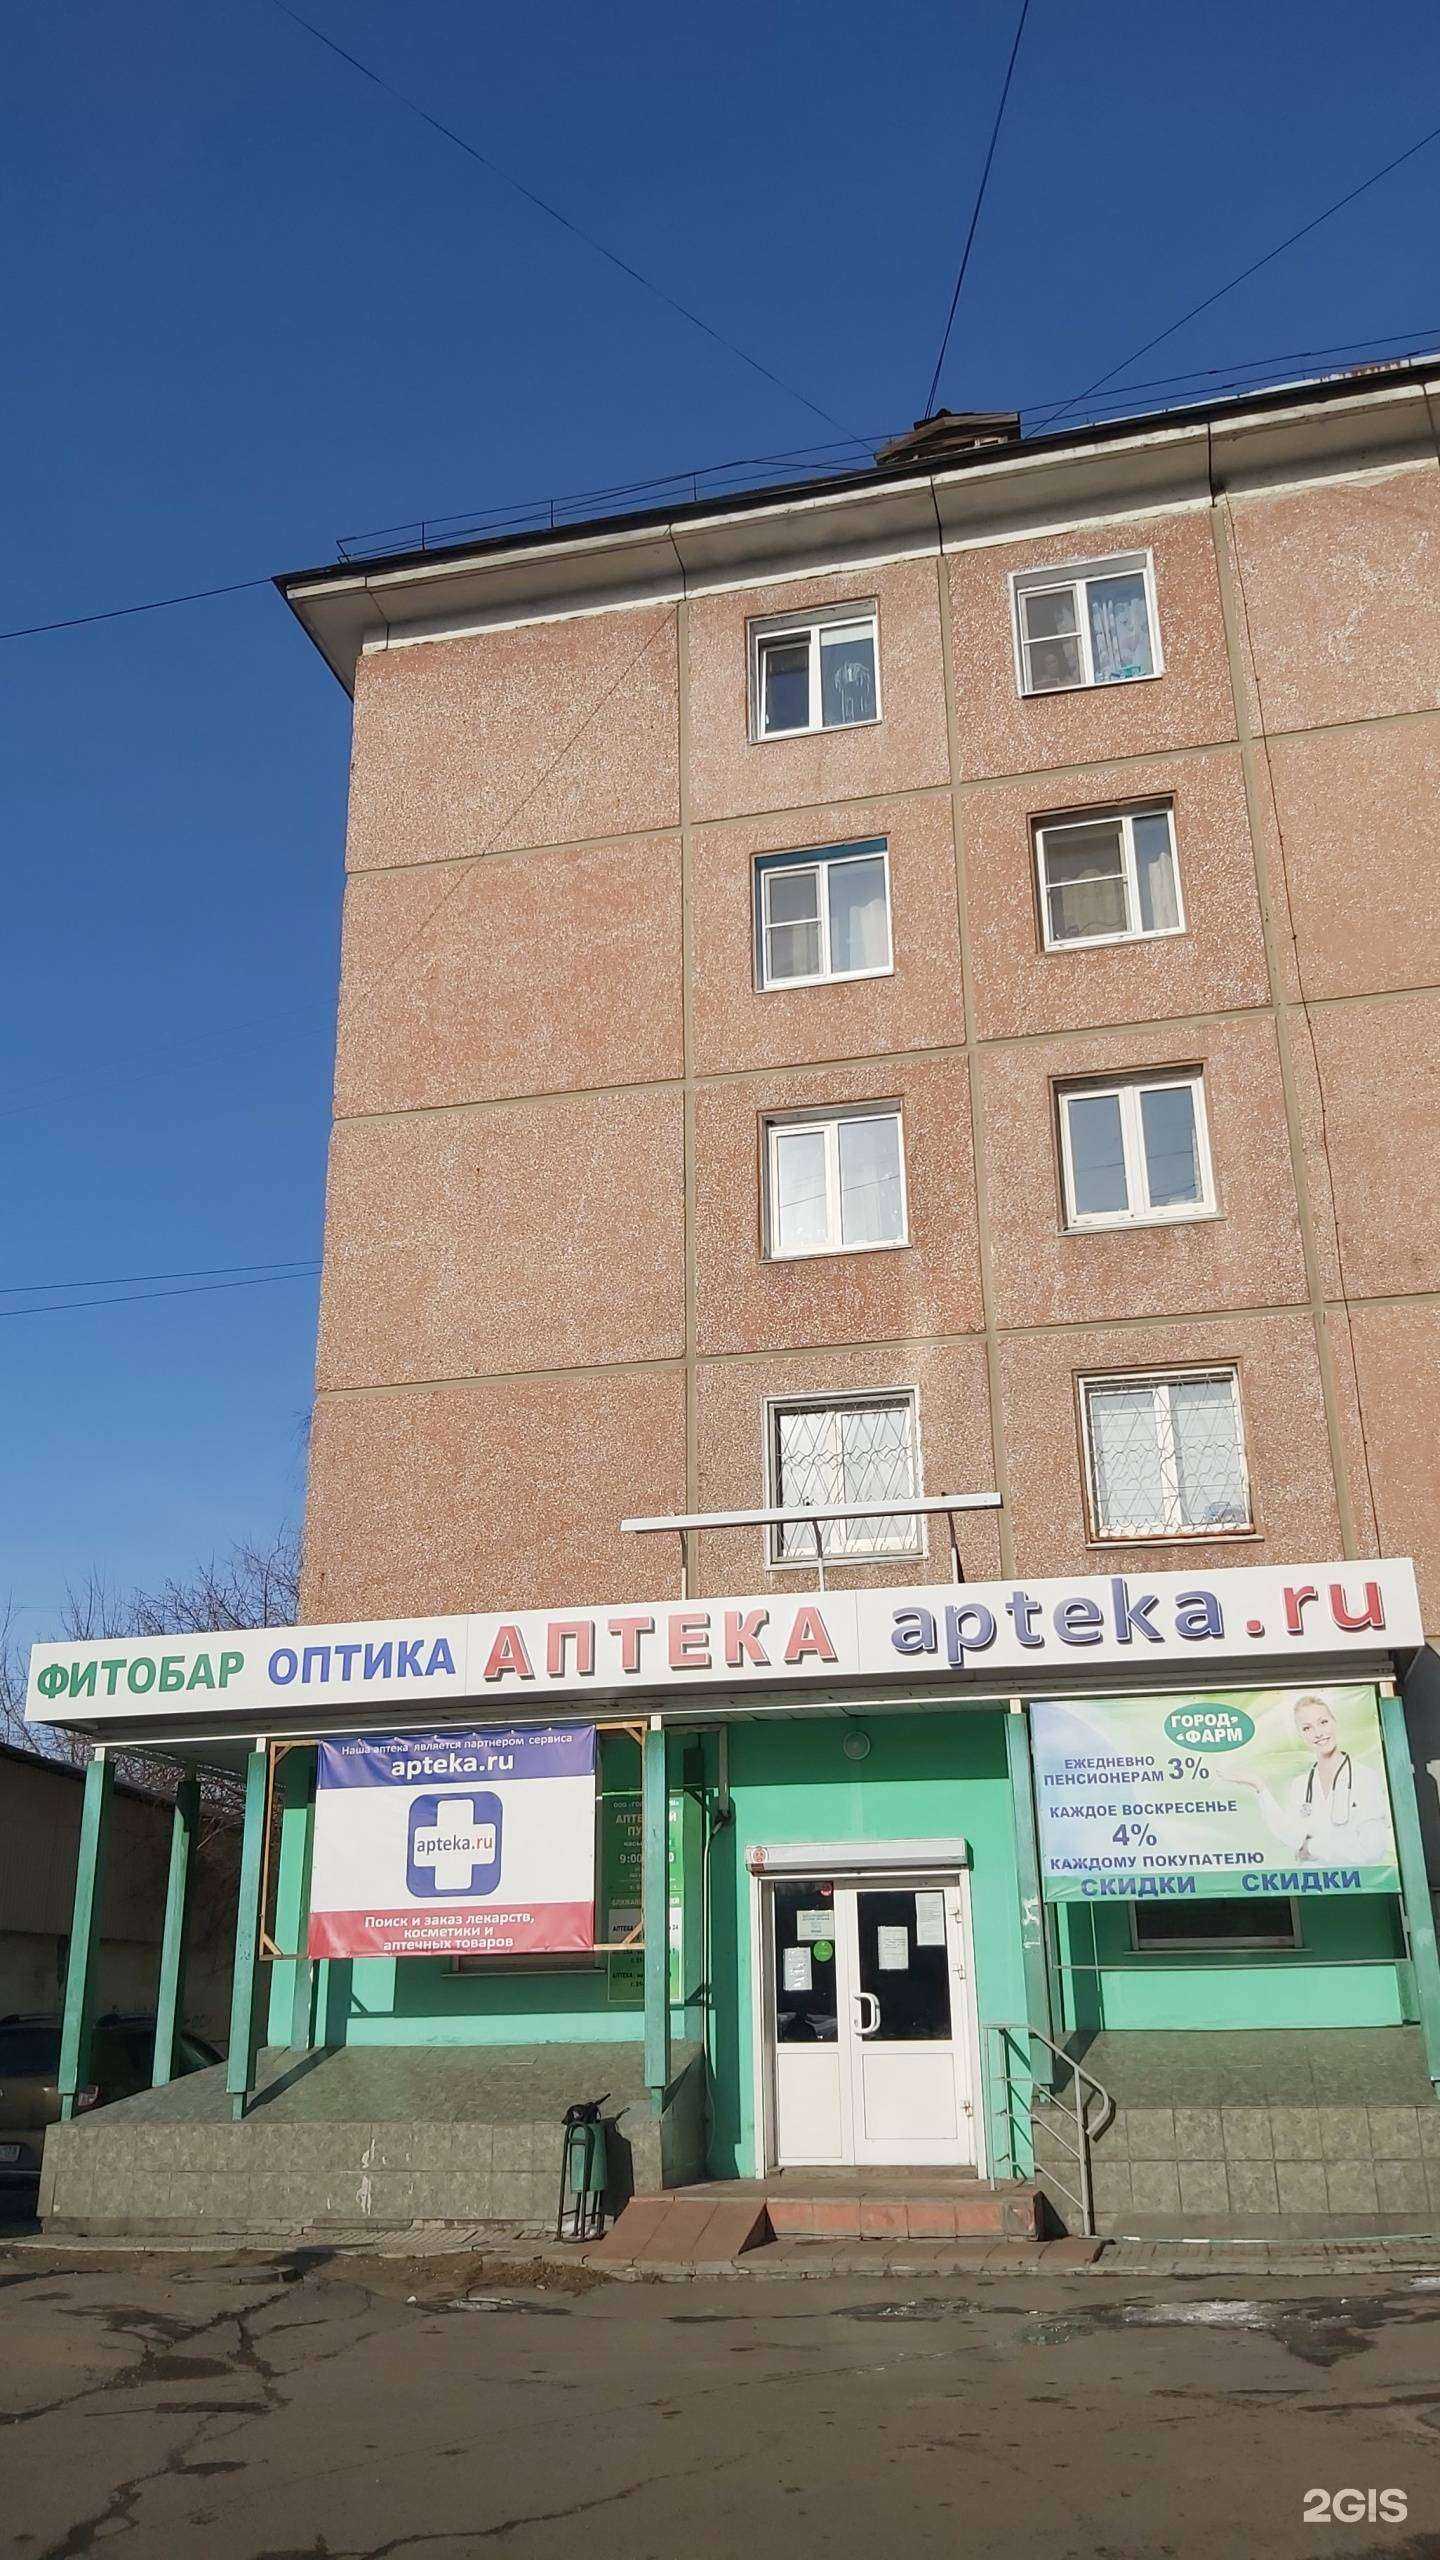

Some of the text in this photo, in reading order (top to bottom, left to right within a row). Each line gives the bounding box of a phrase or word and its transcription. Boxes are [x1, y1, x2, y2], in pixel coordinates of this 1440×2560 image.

[37, 1577, 1386, 1698] ФИТОБАР ОПТИКА АПТЕКА apteka.ru
[342, 1734, 573, 1755] Наша аптека является партнером сервиса
[391, 1753, 514, 1780] apteka.ru
[1065, 1756, 1209, 1780] ЕЖЕДНЕВНО 3%
[1044, 1771, 1164, 1786] ПЕНСИОНЕРАМ
[1050, 1800, 1238, 1819] КАЖДОЕ ВОСКРЕСЕНЬЕ
[417, 1834, 493, 1855] apteka.ru
[1112, 1823, 1157, 1846] 4%
[1051, 1852, 1264, 1871] КАЖДОМУ ПОКУПАТЕЛЮ
[1081, 1870, 1361, 1897] СКИДКИ СКИДКИ
[365, 1913, 534, 1928] Поиск и заказ лекарств,
[404, 1926, 493, 1938] косметики и
[383, 1937, 513, 1950] аптечных товаров
